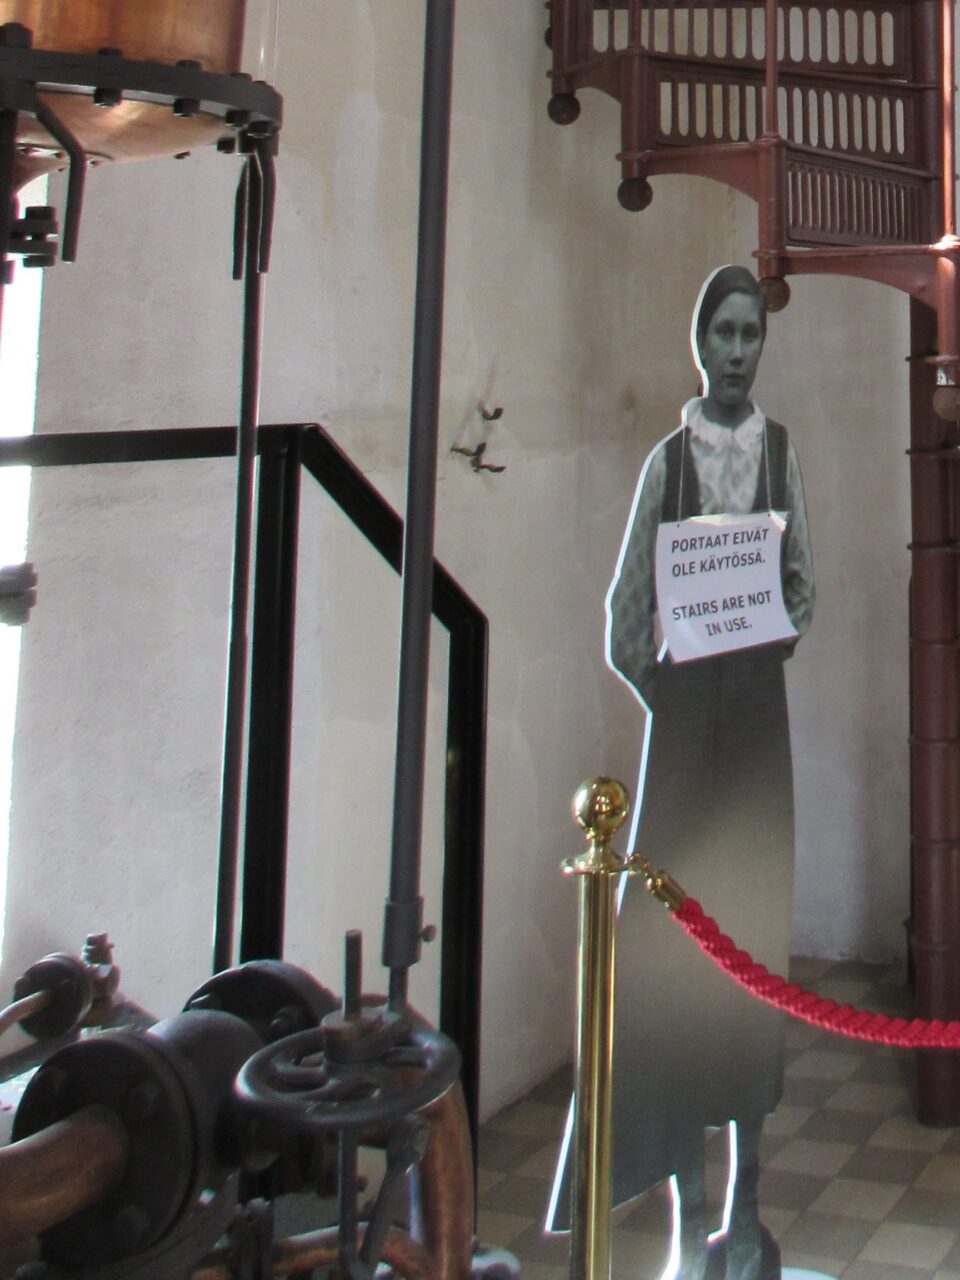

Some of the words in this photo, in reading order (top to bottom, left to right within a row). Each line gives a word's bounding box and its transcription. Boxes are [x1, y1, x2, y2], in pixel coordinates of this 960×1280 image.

[671, 534, 730, 553] PORTAAT
[732, 527, 769, 545] EIVÄT
[672, 561, 697, 578] OLE
[700, 548, 766, 573] KÄYTÖSSÄ.
[672, 599, 719, 621] STAIRS
[722, 595, 745, 611] ARE
[748, 590, 771, 606] NOT
[705, 621, 722, 637] IN
[724, 616, 753, 633] USE.
